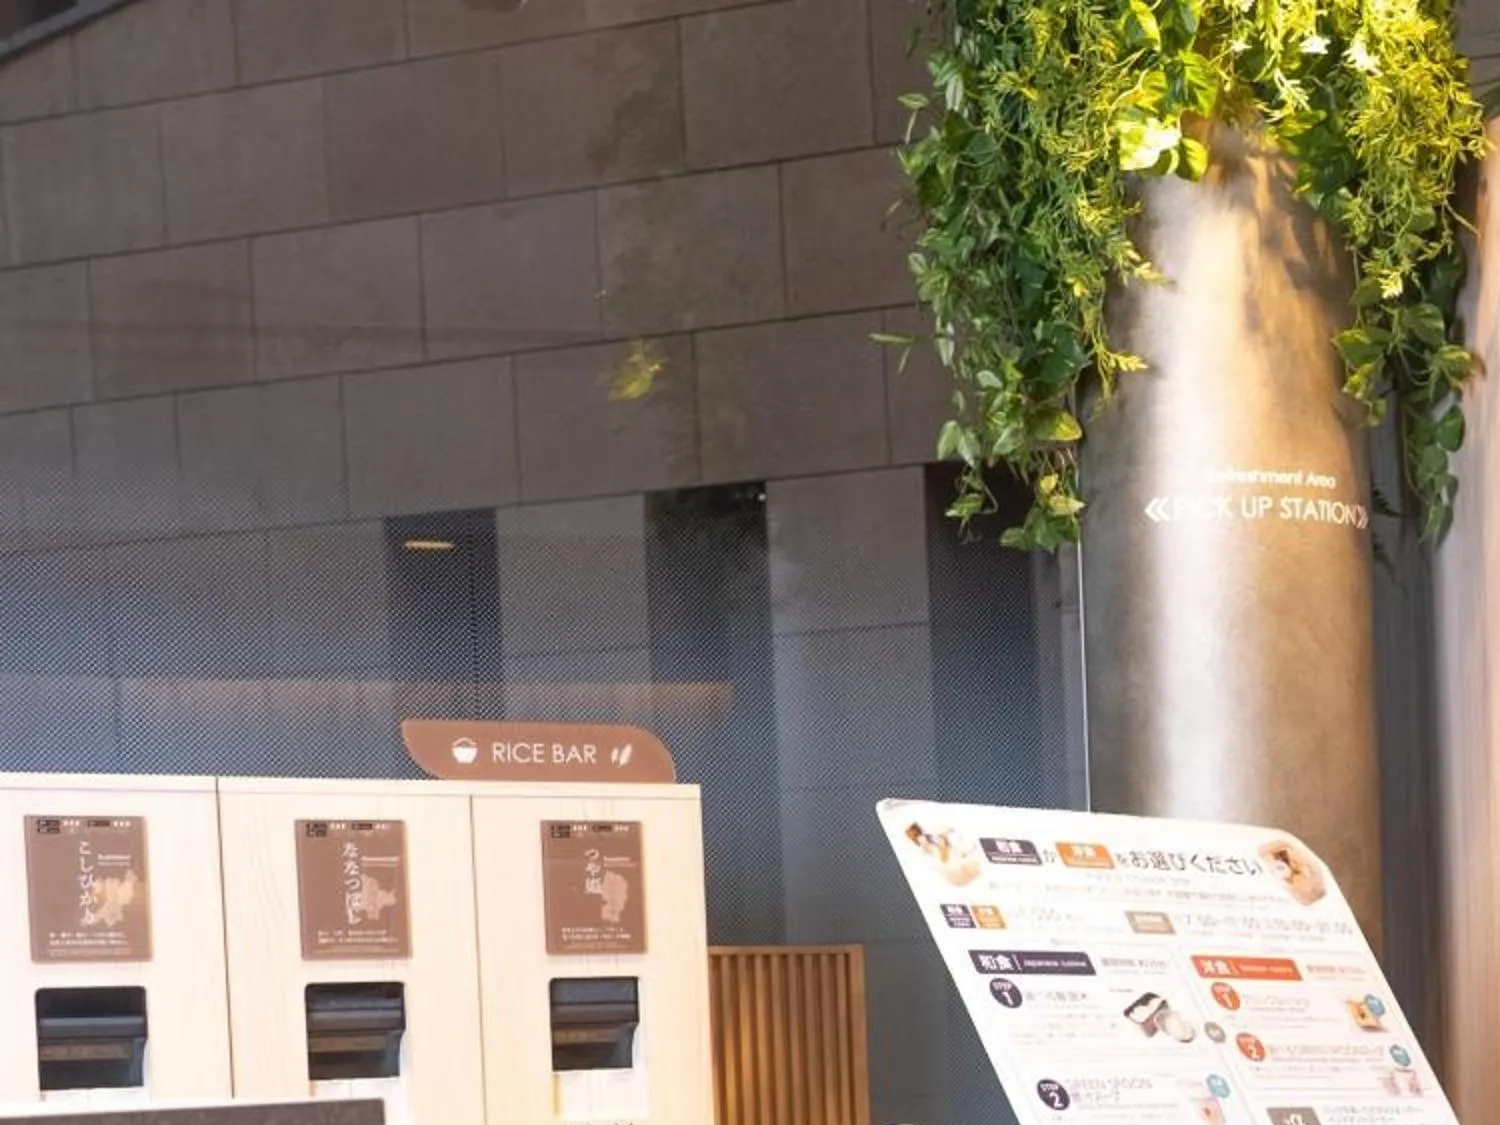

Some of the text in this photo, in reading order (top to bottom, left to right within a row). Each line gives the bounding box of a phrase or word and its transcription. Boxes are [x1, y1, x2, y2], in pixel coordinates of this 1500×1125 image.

[1241, 496, 1273, 519] UP
[1279, 496, 1357, 525] STATION
[492, 742, 597, 764] RICE BAR
[1049, 1092, 1065, 1108] 2
